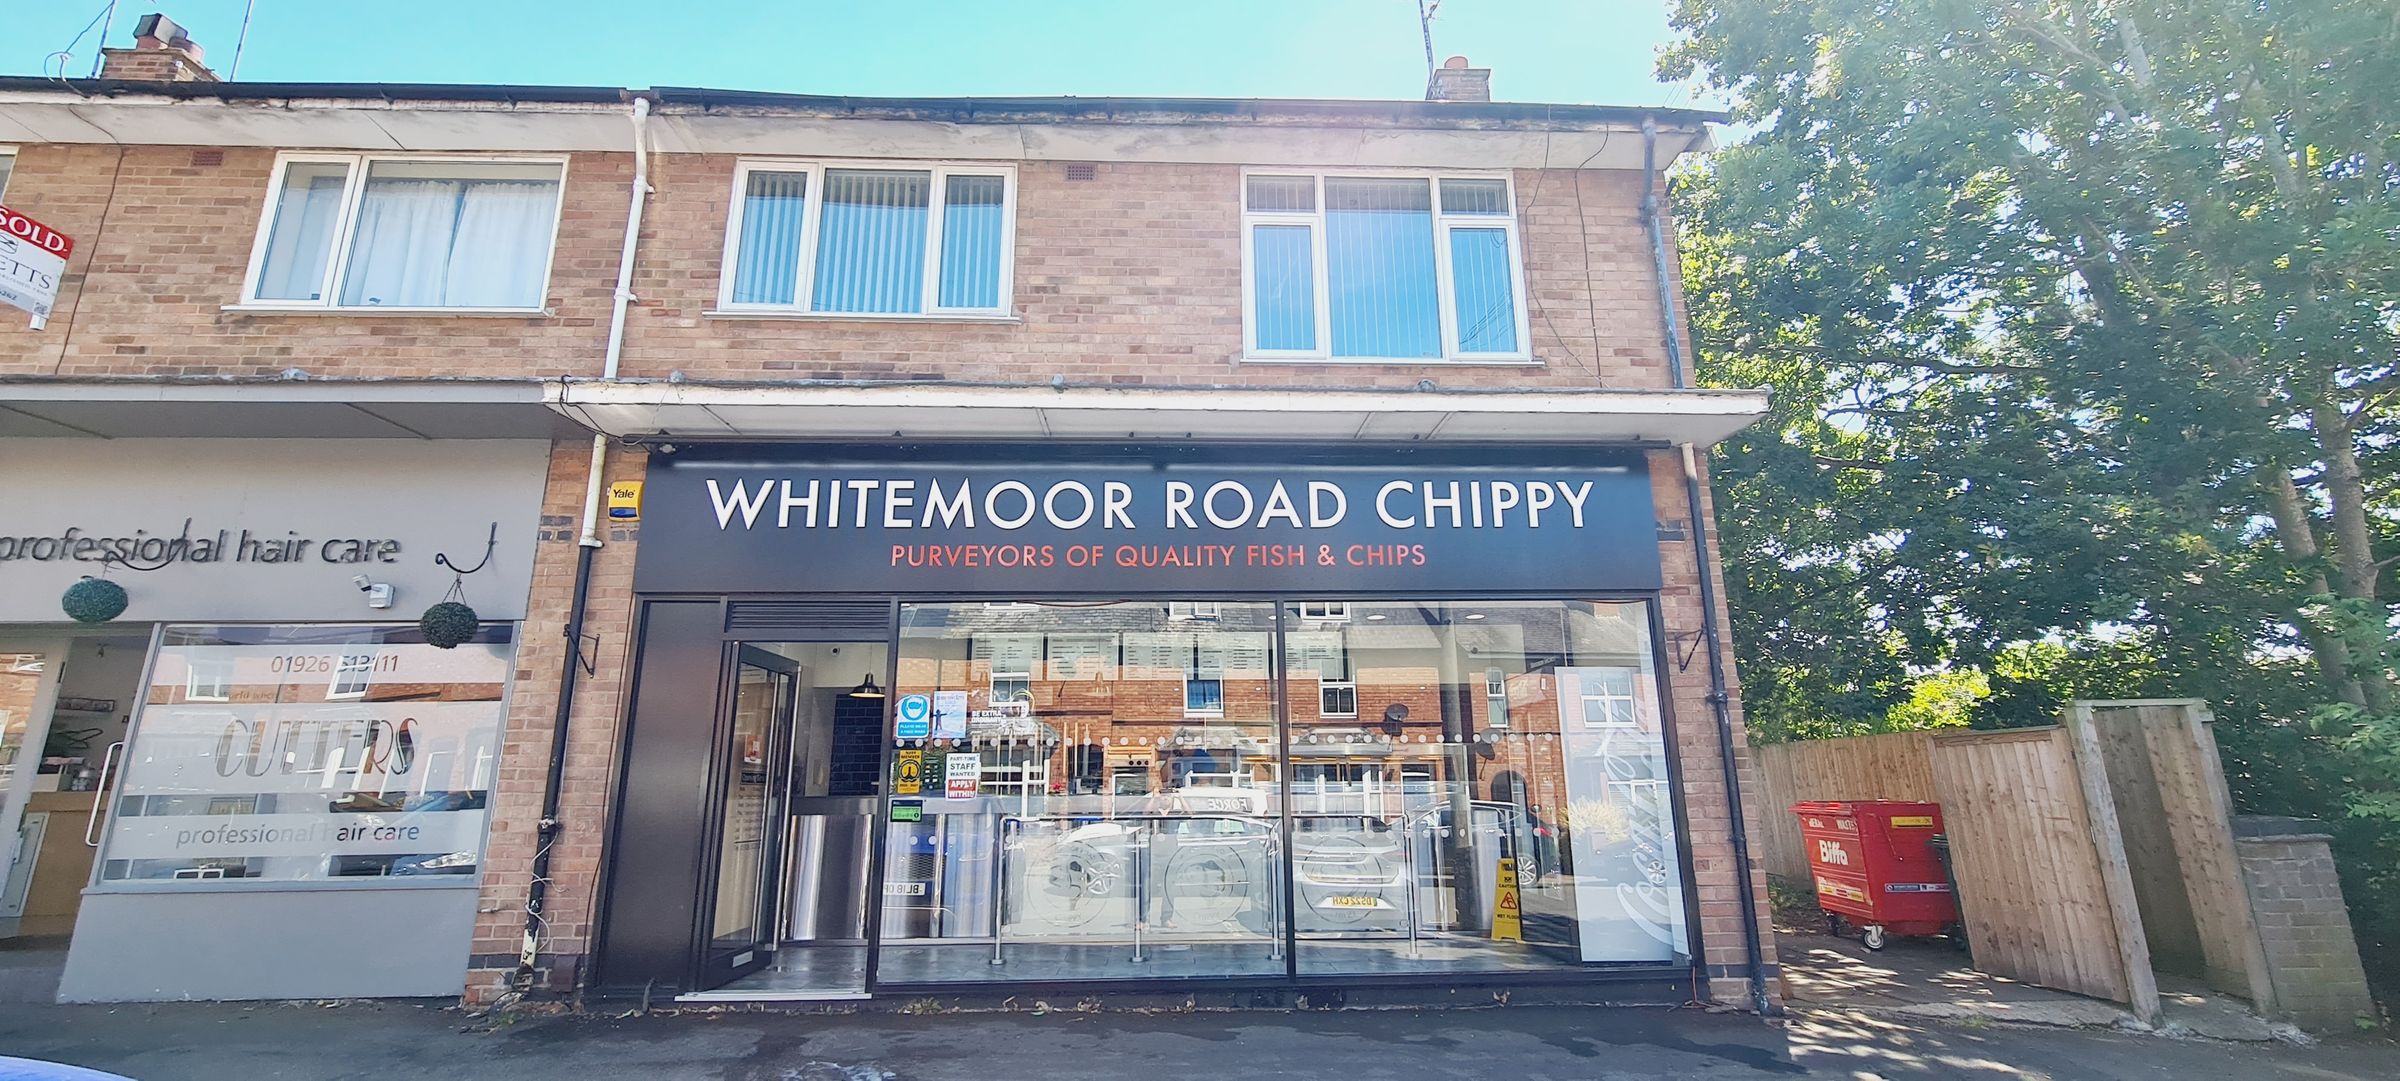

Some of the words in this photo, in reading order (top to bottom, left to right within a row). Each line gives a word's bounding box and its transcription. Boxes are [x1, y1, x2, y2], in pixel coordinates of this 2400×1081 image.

[613, 489, 635, 498] Yale
[706, 477, 1136, 530] WHITEMOOR
[1165, 479, 1348, 529] ROAD
[1375, 480, 1594, 529] CHIPPY
[236, 529, 314, 563] hair
[321, 538, 401, 563] care
[890, 544, 1055, 568] PURVEYORS
[1065, 544, 1104, 568] OF
[1115, 544, 1236, 568] QUALITY
[1246, 544, 1305, 568] FISH
[1317, 544, 1336, 567] &
[1347, 543, 1427, 567] CHIPS
[271, 655, 330, 673] 01926
[950, 763, 976, 771] STAFF
[949, 790, 975, 798] WITHIN
[951, 780, 974, 788] APPLY
[176, 823, 316, 849] professional
[374, 825, 419, 841] care
[1819, 839, 1849, 866] Biffa
